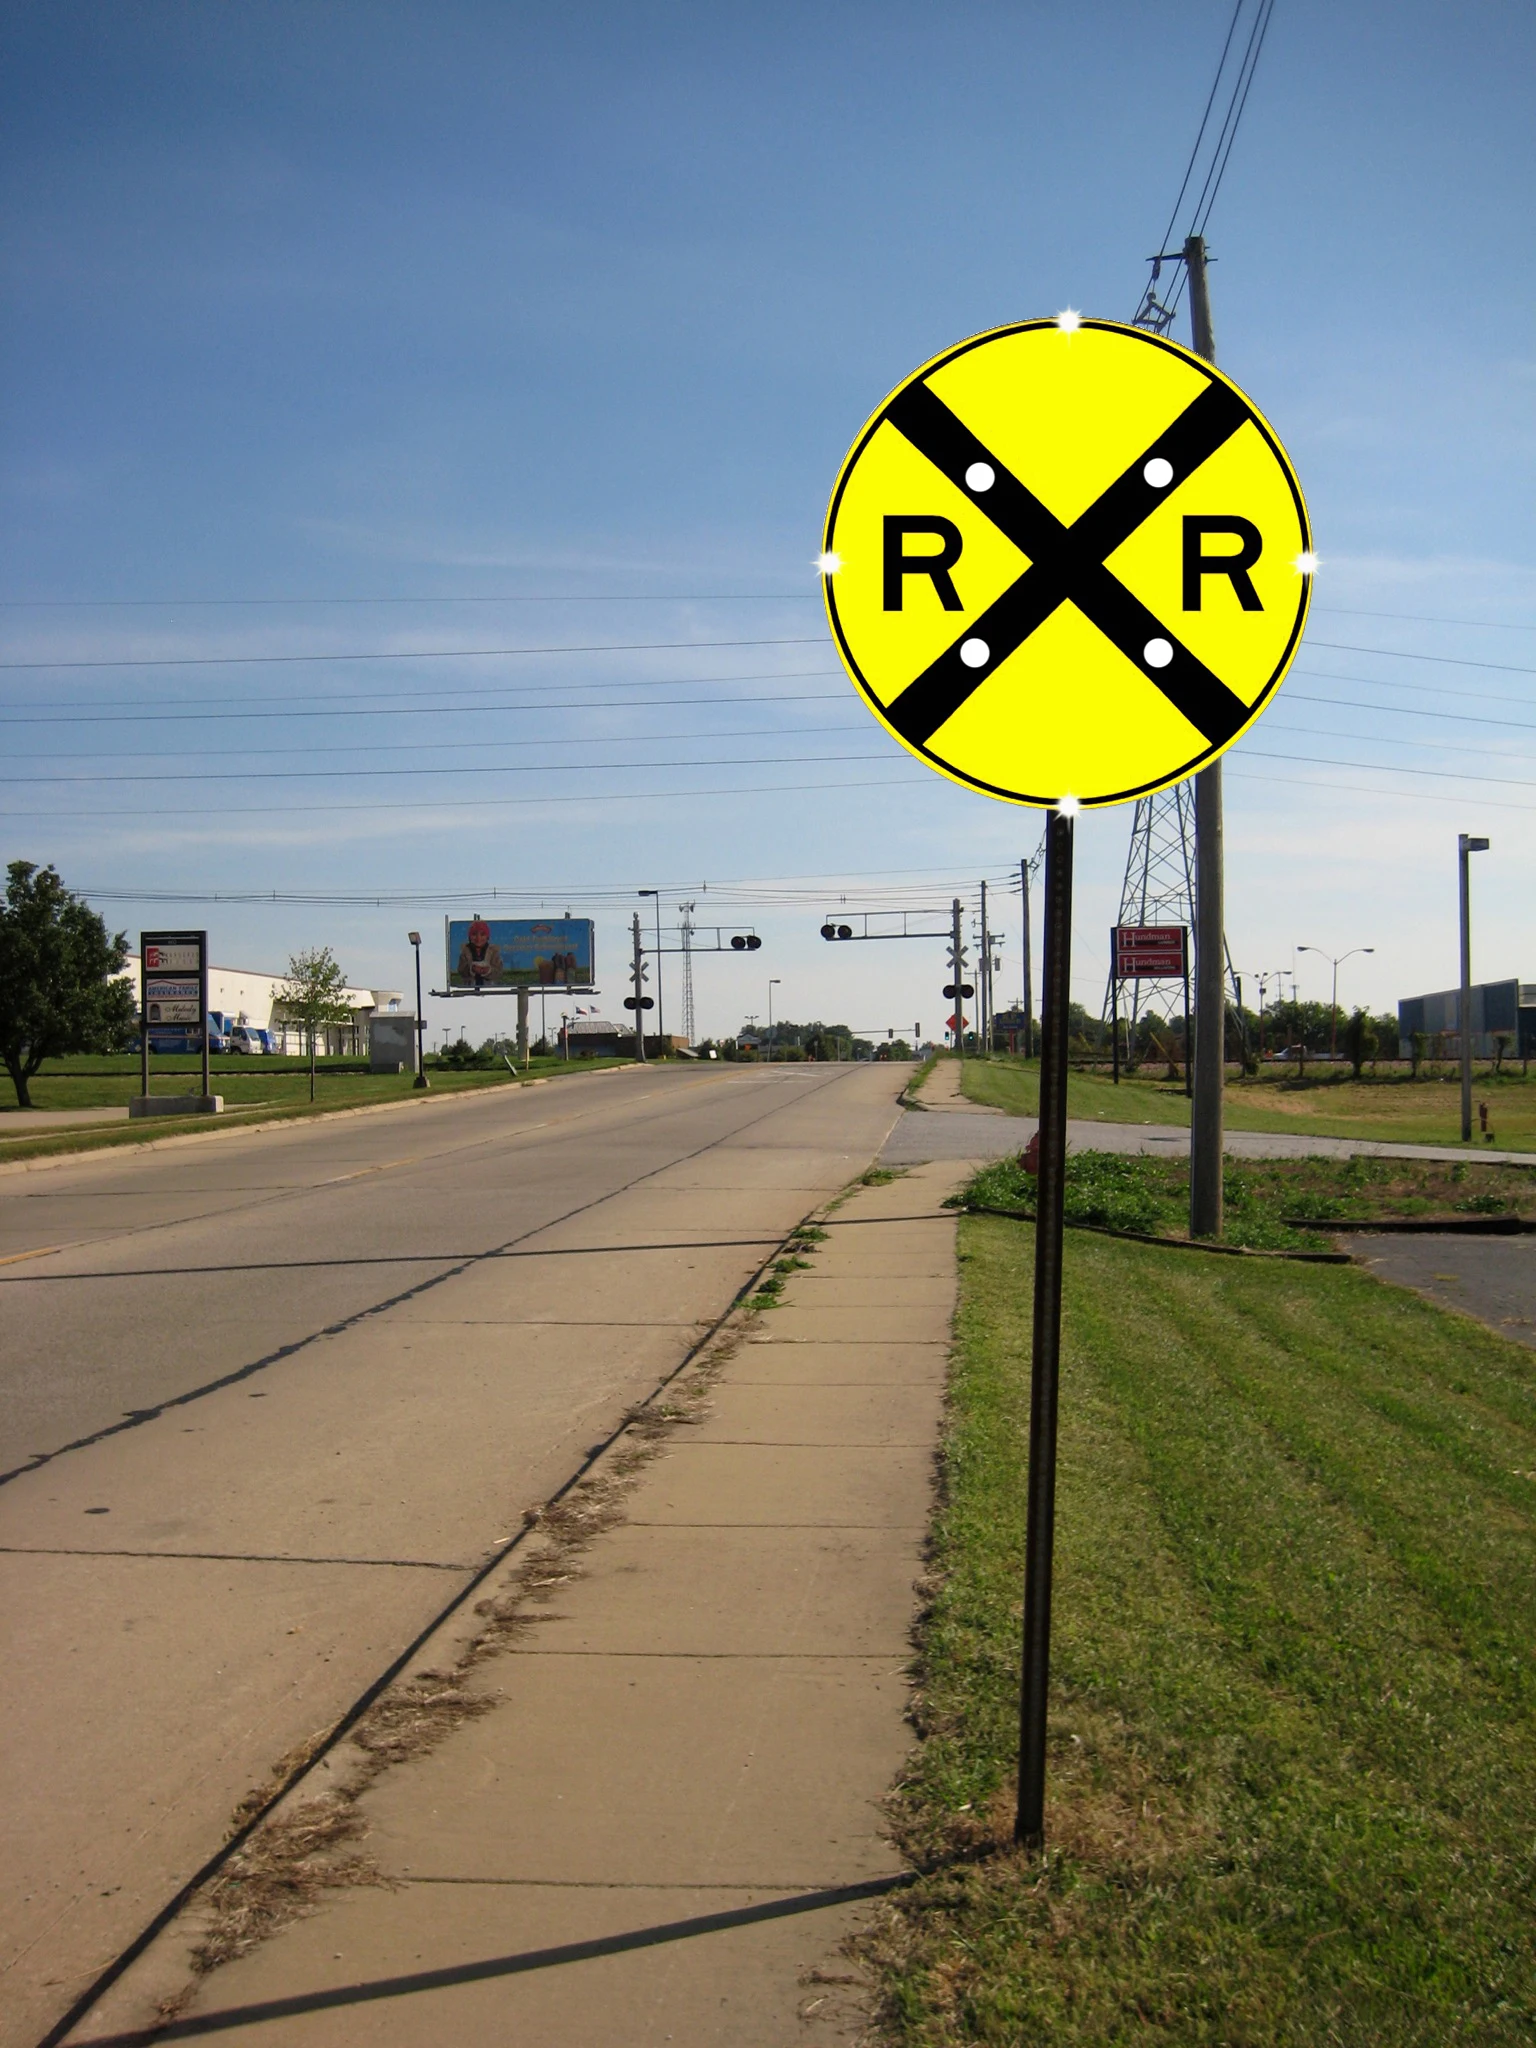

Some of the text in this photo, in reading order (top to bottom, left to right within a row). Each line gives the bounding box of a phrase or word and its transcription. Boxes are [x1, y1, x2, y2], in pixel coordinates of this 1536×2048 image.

[883, 515, 1264, 611] R R
[1122, 932, 1171, 947] Hundman
[1123, 957, 1171, 973] Hundman
